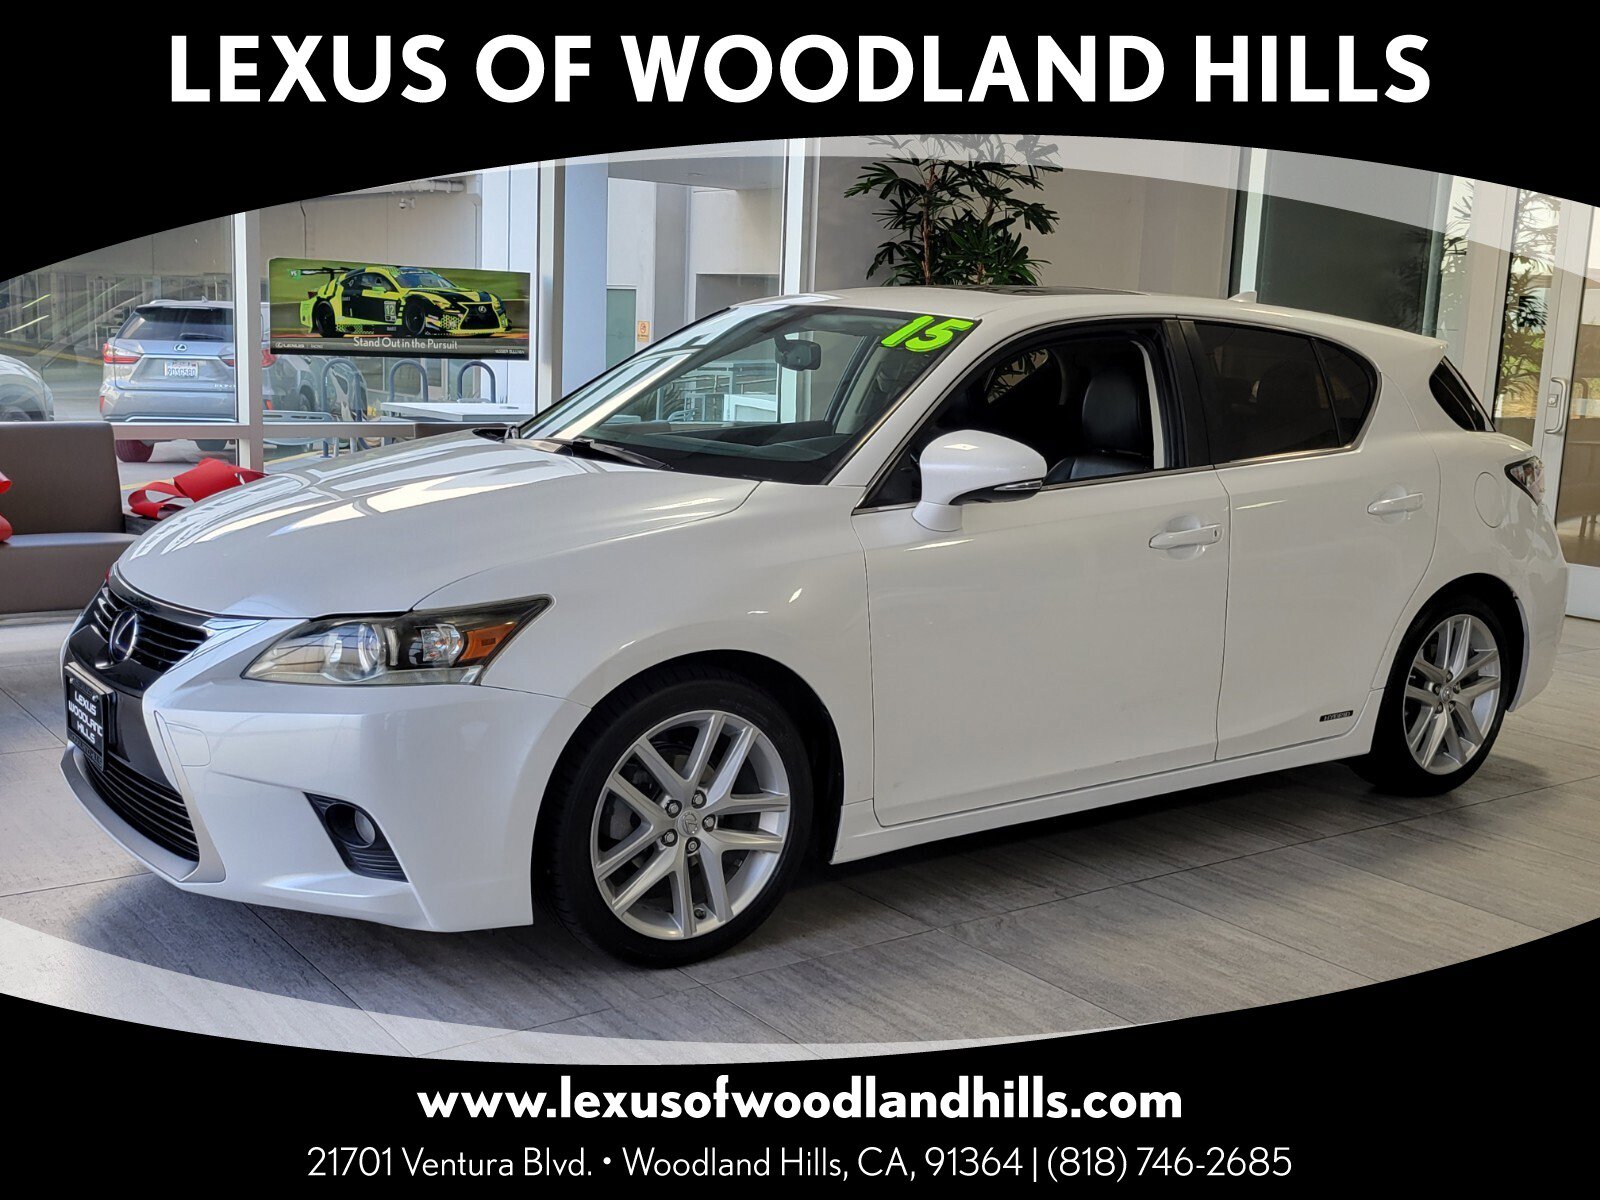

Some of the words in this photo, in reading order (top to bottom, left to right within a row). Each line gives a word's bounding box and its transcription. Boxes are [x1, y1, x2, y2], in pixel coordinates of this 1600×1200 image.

[385, 304, 395, 315] 12
[353, 337, 380, 347] Stand
[382, 337, 400, 348] Out
[401, 338, 410, 348] in
[411, 338, 426, 349] the
[427, 339, 458, 350] Pursuit
[881, 315, 974, 353] 15
[74, 690, 97, 716] LEXUS
[76, 720, 96, 744] HILLS
